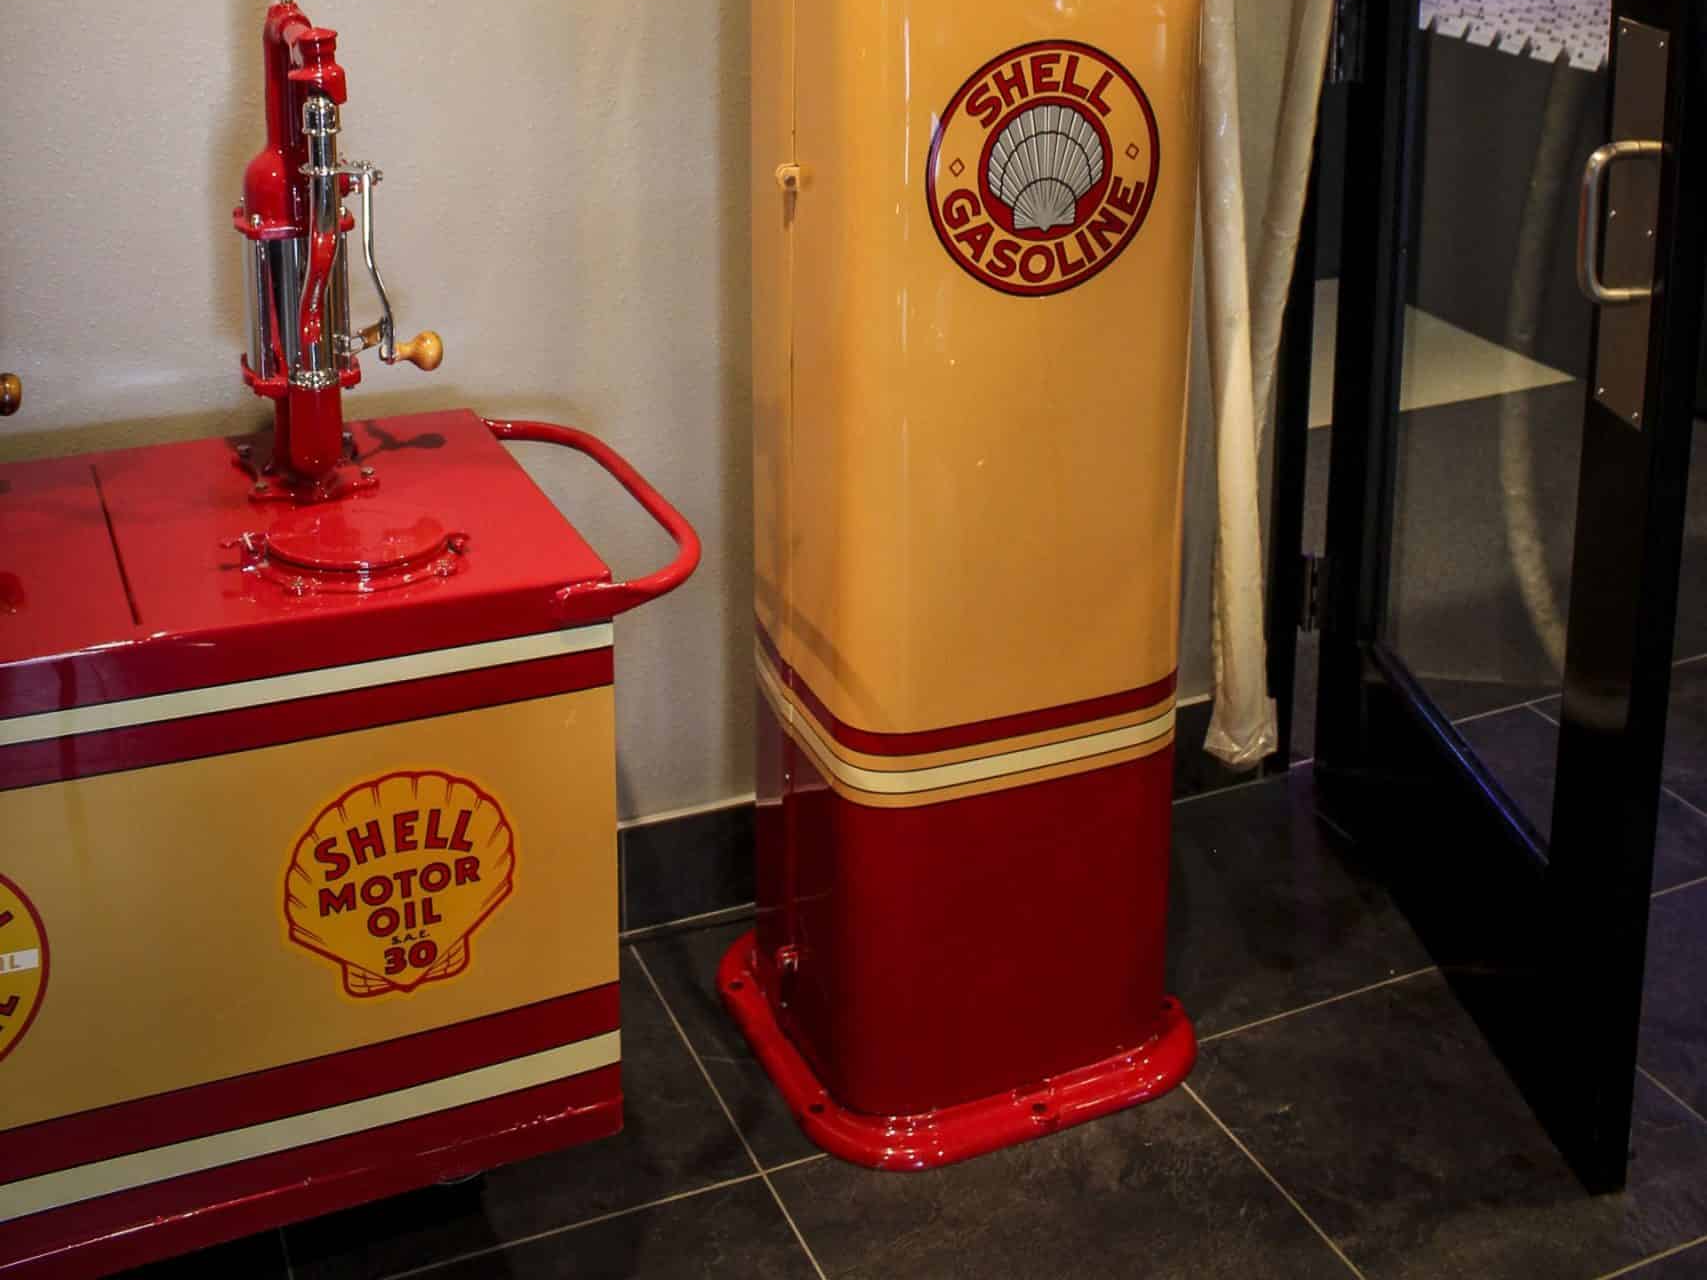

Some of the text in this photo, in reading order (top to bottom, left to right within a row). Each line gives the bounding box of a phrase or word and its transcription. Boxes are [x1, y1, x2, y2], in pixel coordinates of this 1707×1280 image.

[965, 54, 1114, 129] SHELL
[942, 176, 1145, 283] GASOLINE
[314, 808, 473, 882] SHELL
[318, 856, 481, 917] MOTOR
[367, 897, 442, 938] OIL
[384, 939, 438, 975] 30
